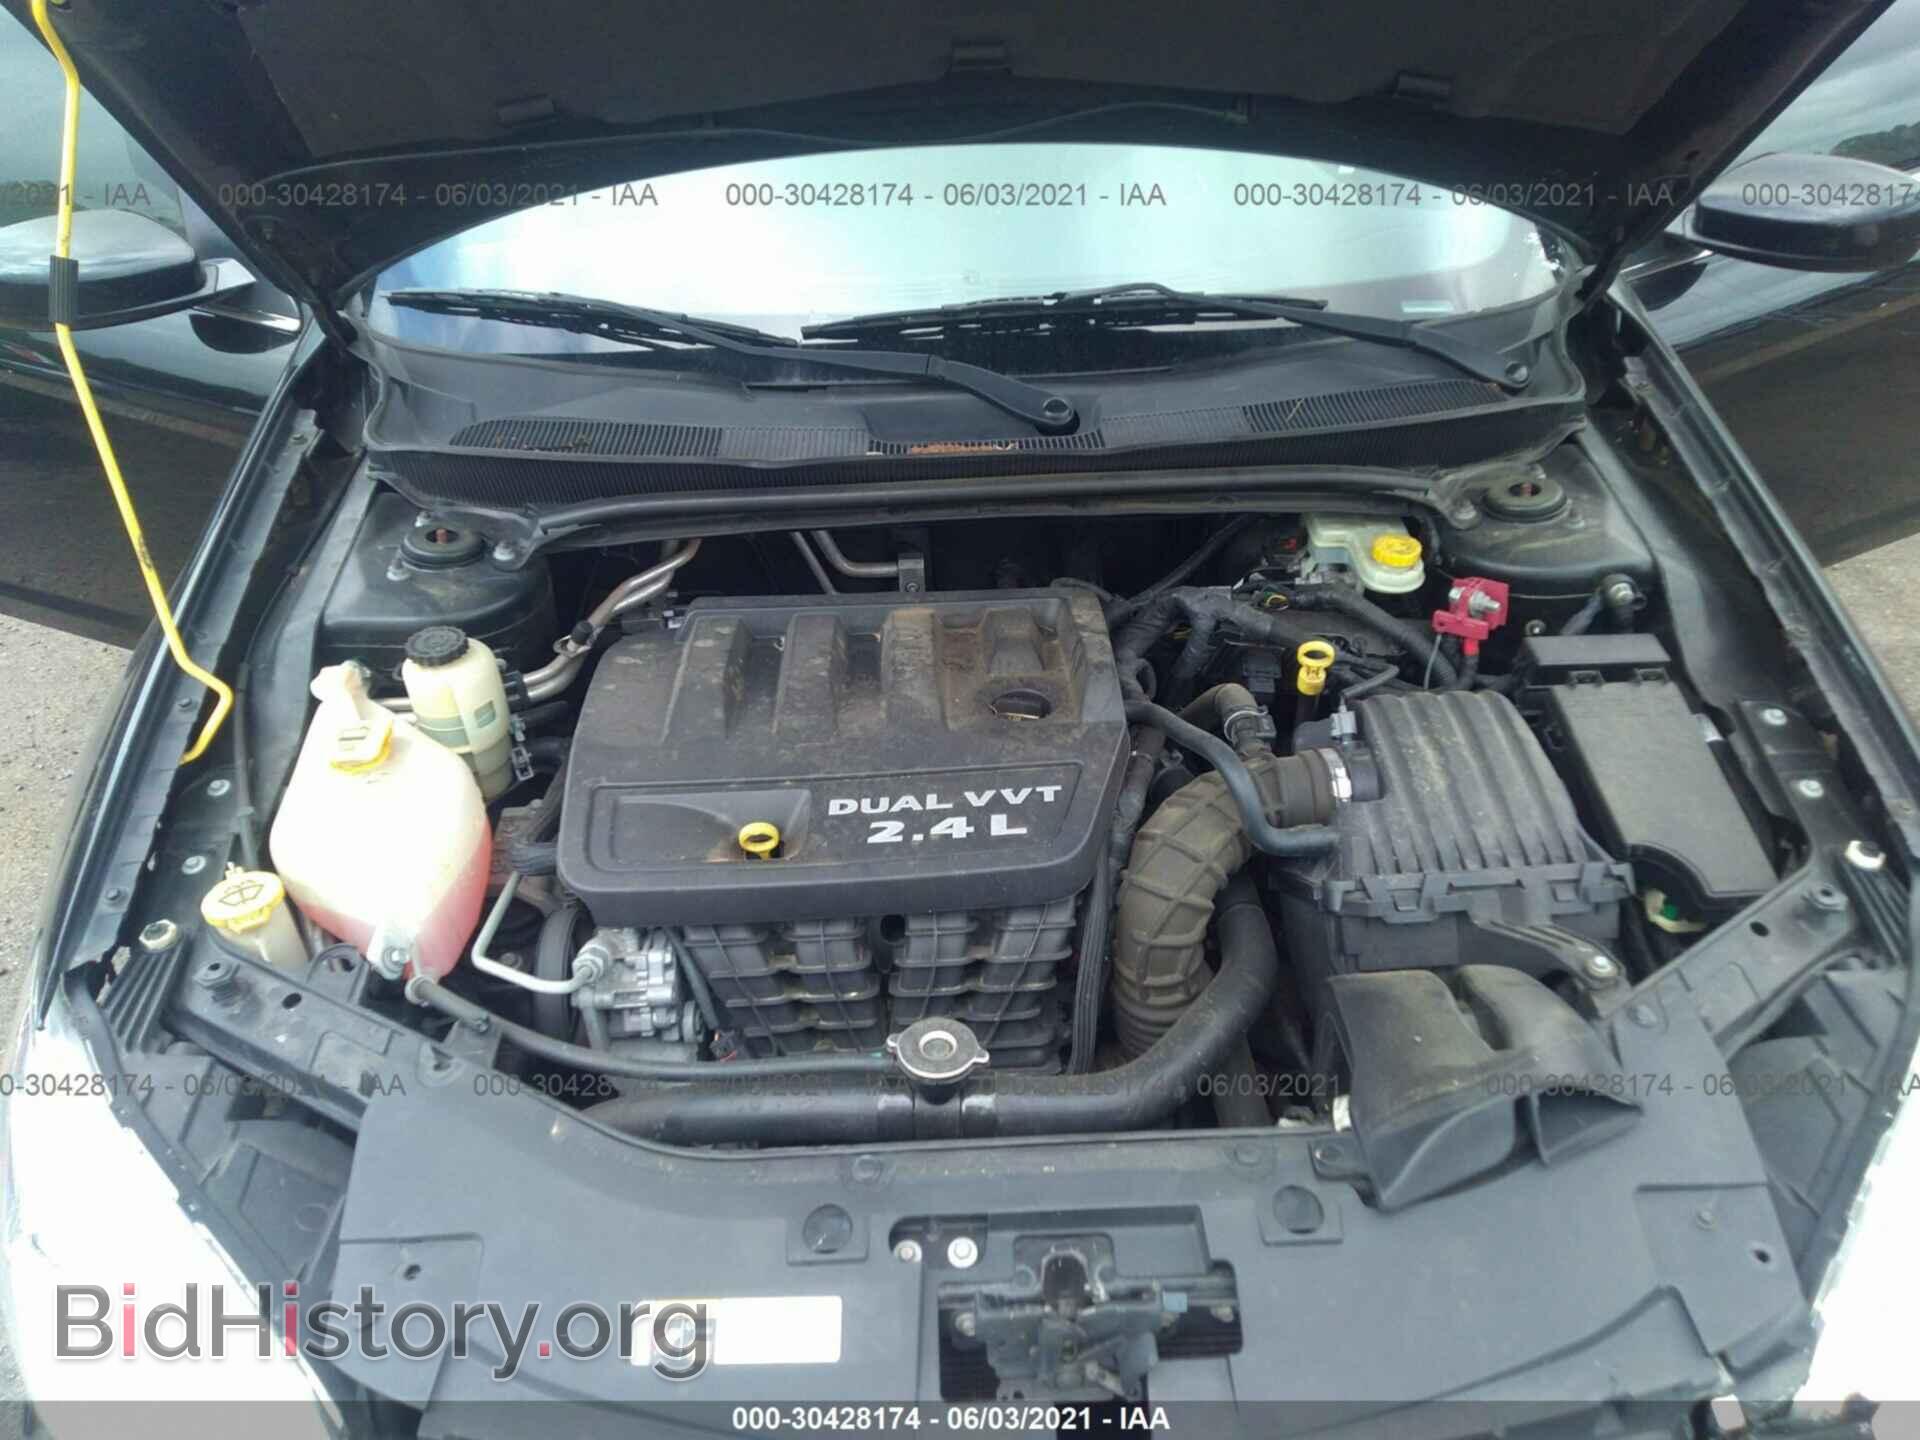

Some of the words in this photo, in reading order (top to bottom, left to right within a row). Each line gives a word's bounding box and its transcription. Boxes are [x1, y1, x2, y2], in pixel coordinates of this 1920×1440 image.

[828, 793, 953, 816] DUAL
[964, 785, 1062, 808] VVT
[866, 815, 975, 844] 2.4
